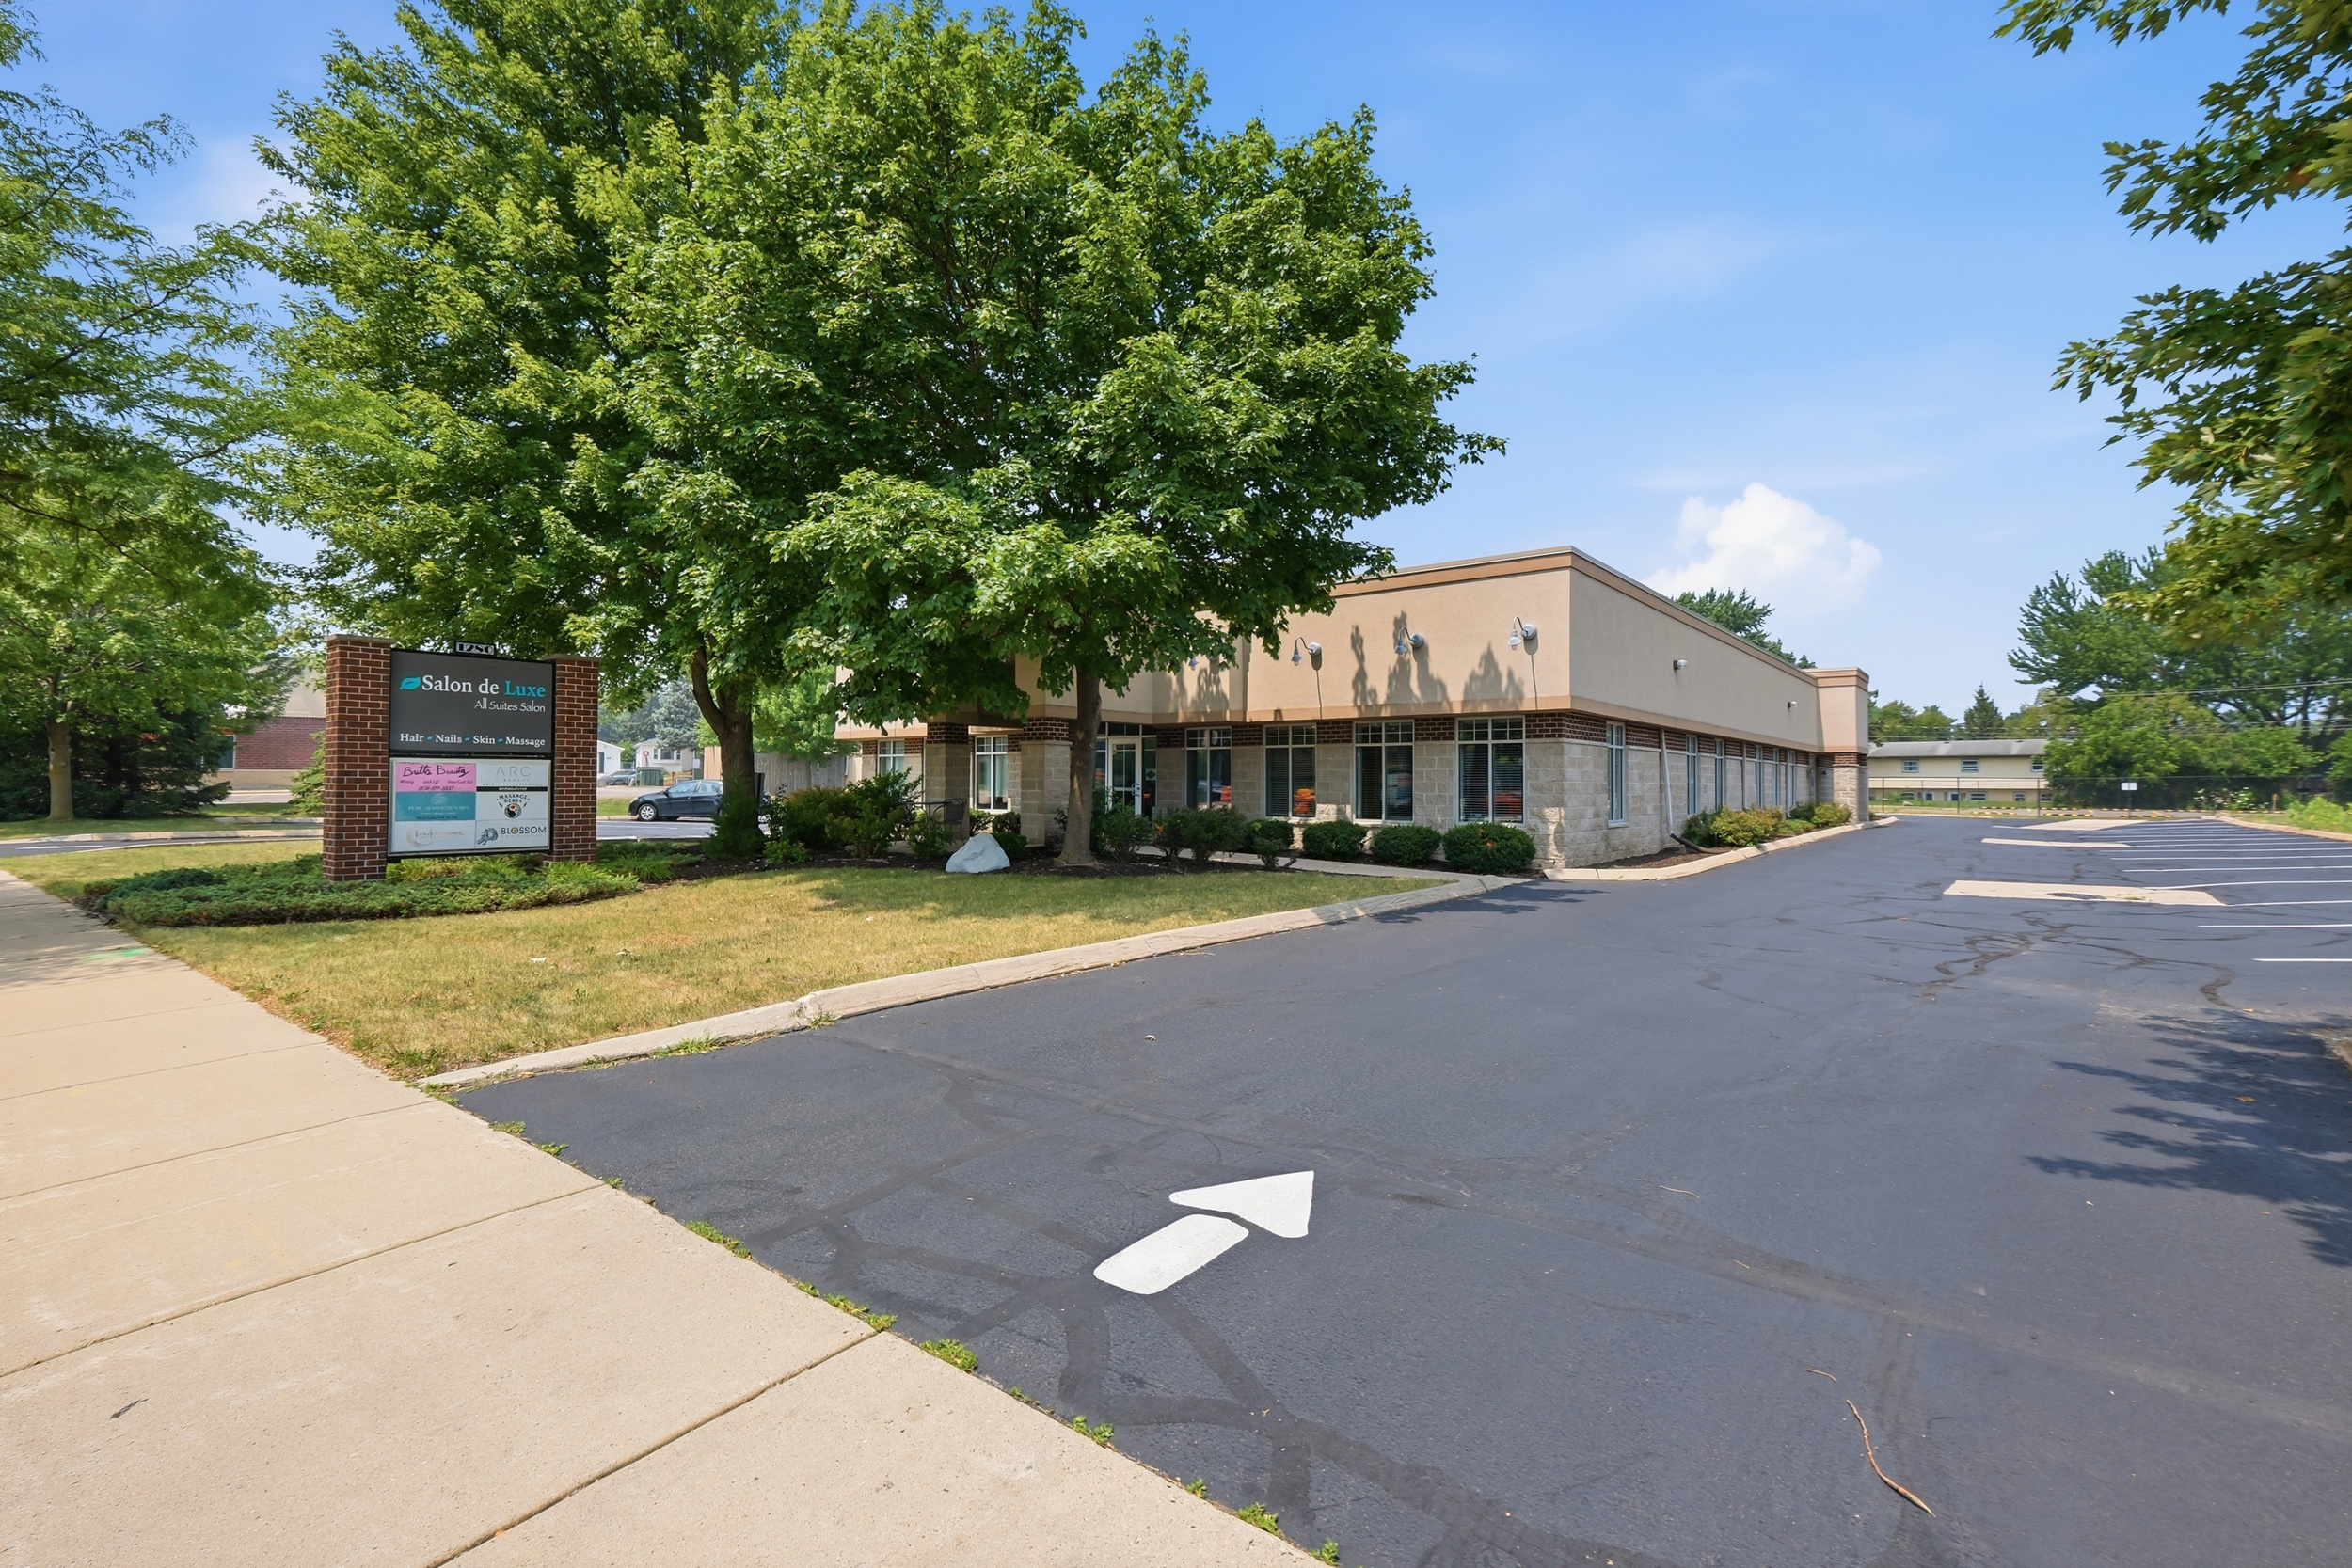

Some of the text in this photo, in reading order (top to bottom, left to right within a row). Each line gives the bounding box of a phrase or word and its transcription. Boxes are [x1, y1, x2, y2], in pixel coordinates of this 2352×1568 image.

[421, 674, 546, 697] Salon de Luxe
[473, 697, 546, 713] All Suites Salon
[400, 733, 546, 748] Hair Nails Skin Massage
[495, 766, 532, 777] ARC
[501, 826, 547, 835] BLOSSOM
